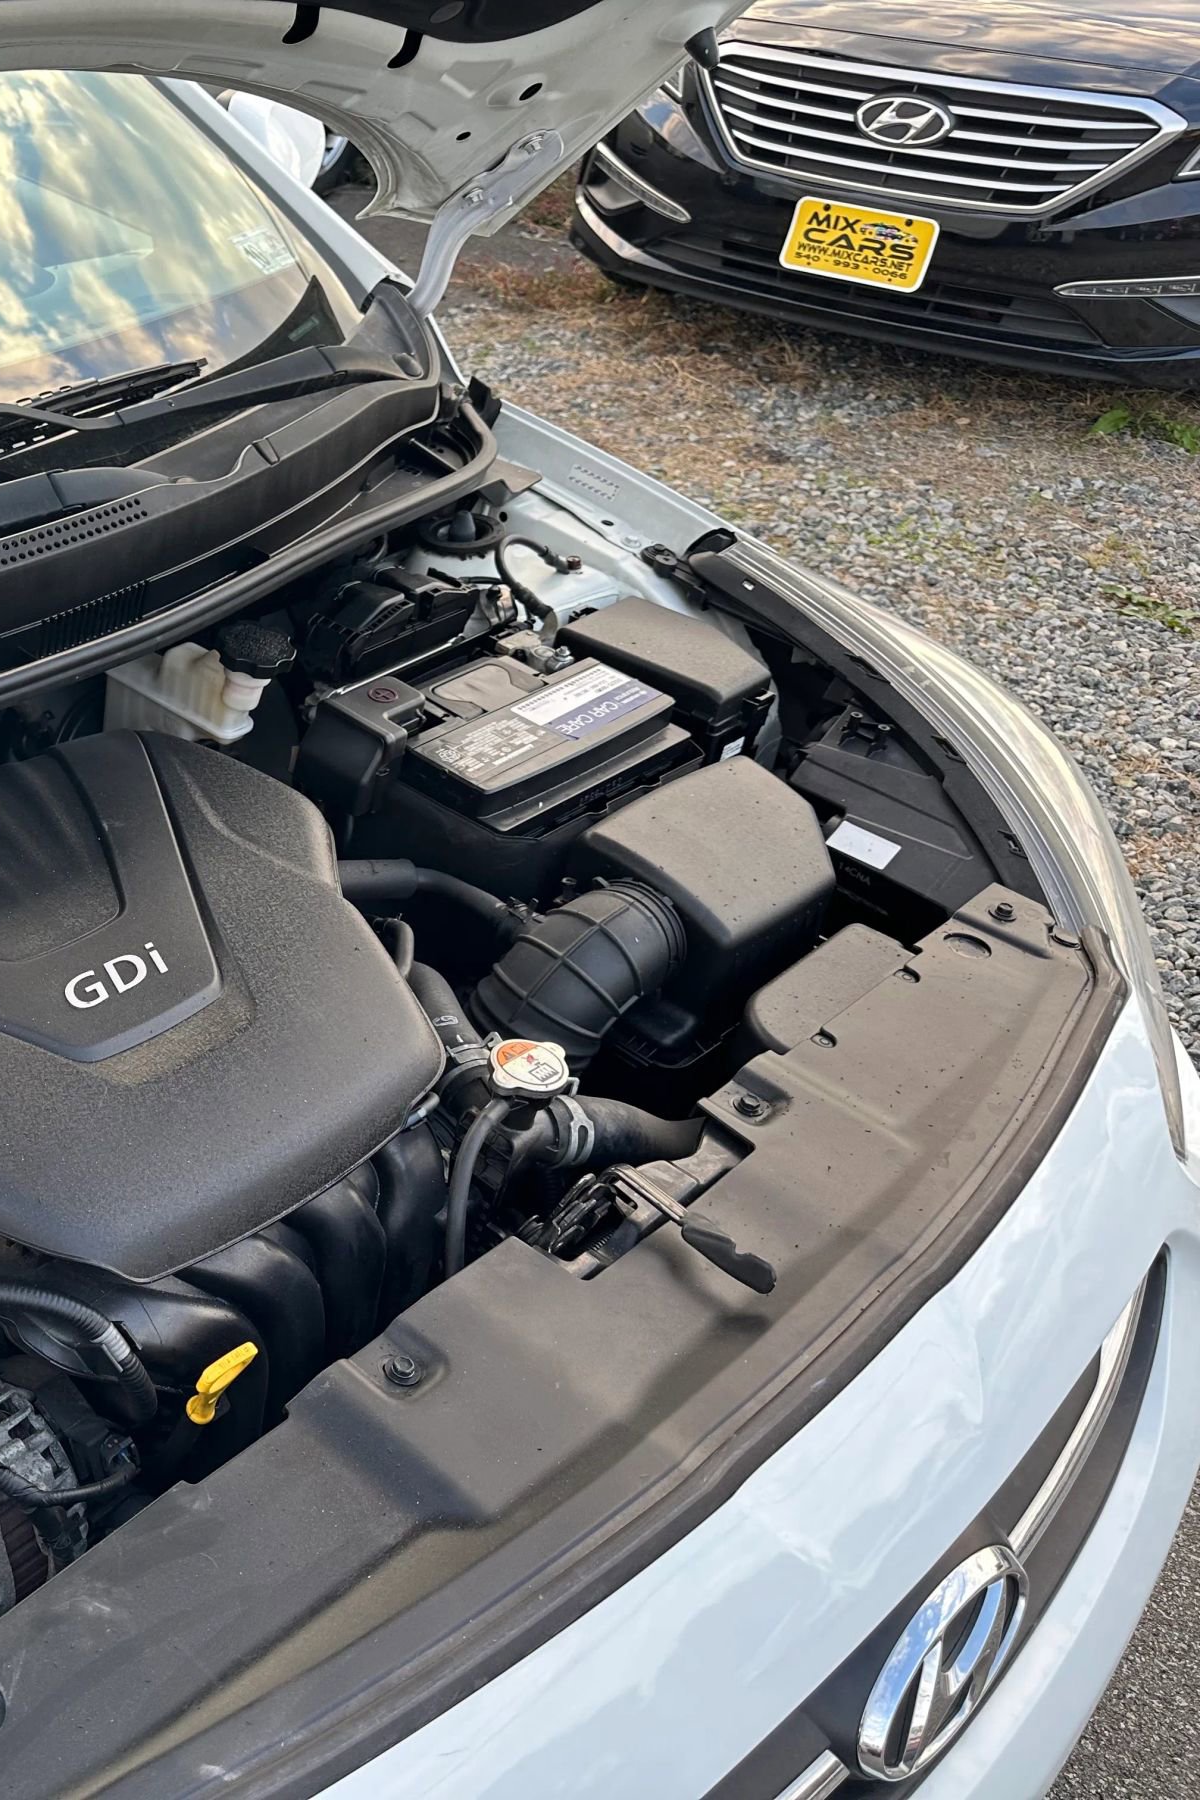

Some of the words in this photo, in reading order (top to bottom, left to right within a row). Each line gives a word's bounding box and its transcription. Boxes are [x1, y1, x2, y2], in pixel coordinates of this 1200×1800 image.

[806, 211, 862, 234] MIX
[797, 242, 913, 272] WWW.MIXCARS.NET
[804, 228, 915, 260] CARS
[794, 252, 821, 262] 540
[833, 259, 860, 270] 993
[872, 267, 908, 280] 0066
[587, 701, 619, 718] CAR
[555, 714, 594, 735] CARE
[64, 941, 169, 1009] GDi
